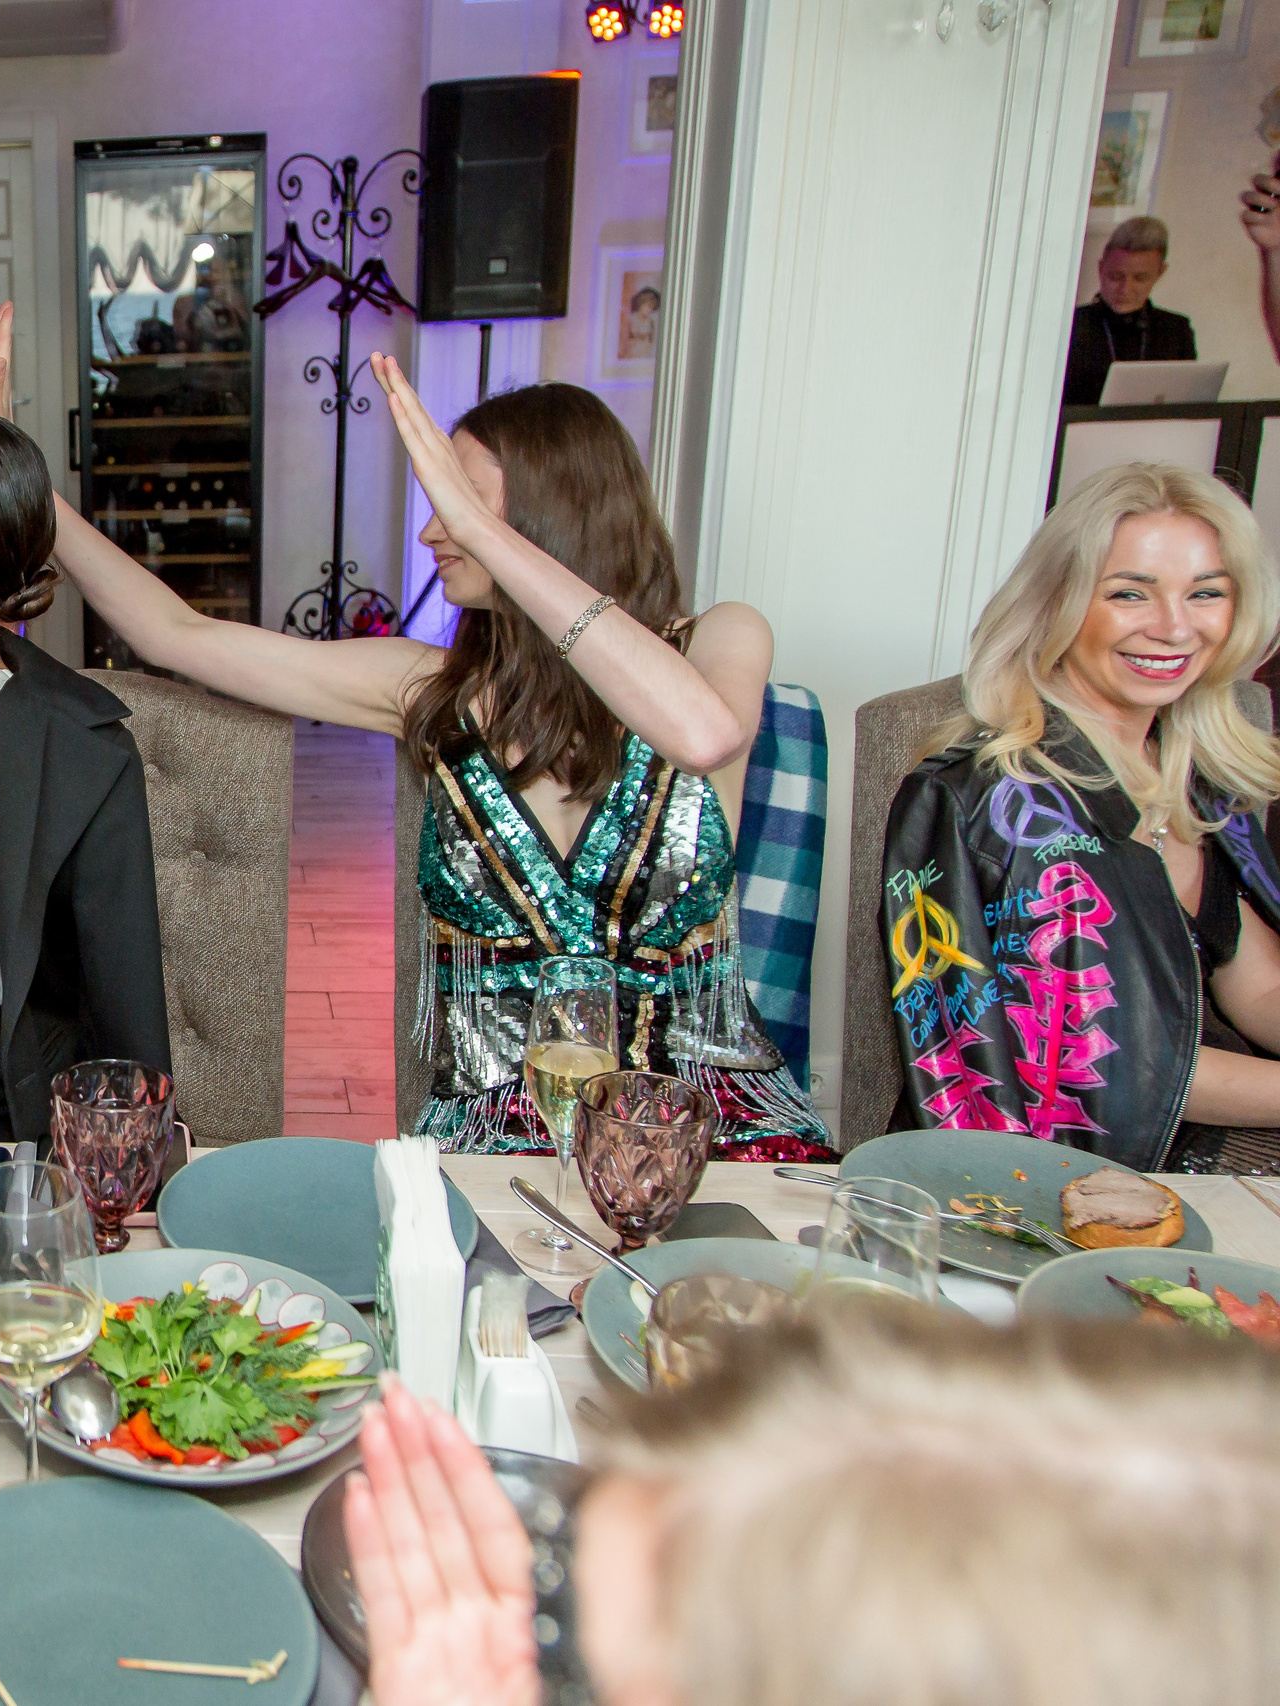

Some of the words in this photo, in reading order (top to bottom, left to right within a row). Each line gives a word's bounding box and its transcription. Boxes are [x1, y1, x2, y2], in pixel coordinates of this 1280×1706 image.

[1033, 833, 1105, 864] FOREVER
[886, 859, 943, 902] FAME
[962, 979, 1002, 1026] LOVE
